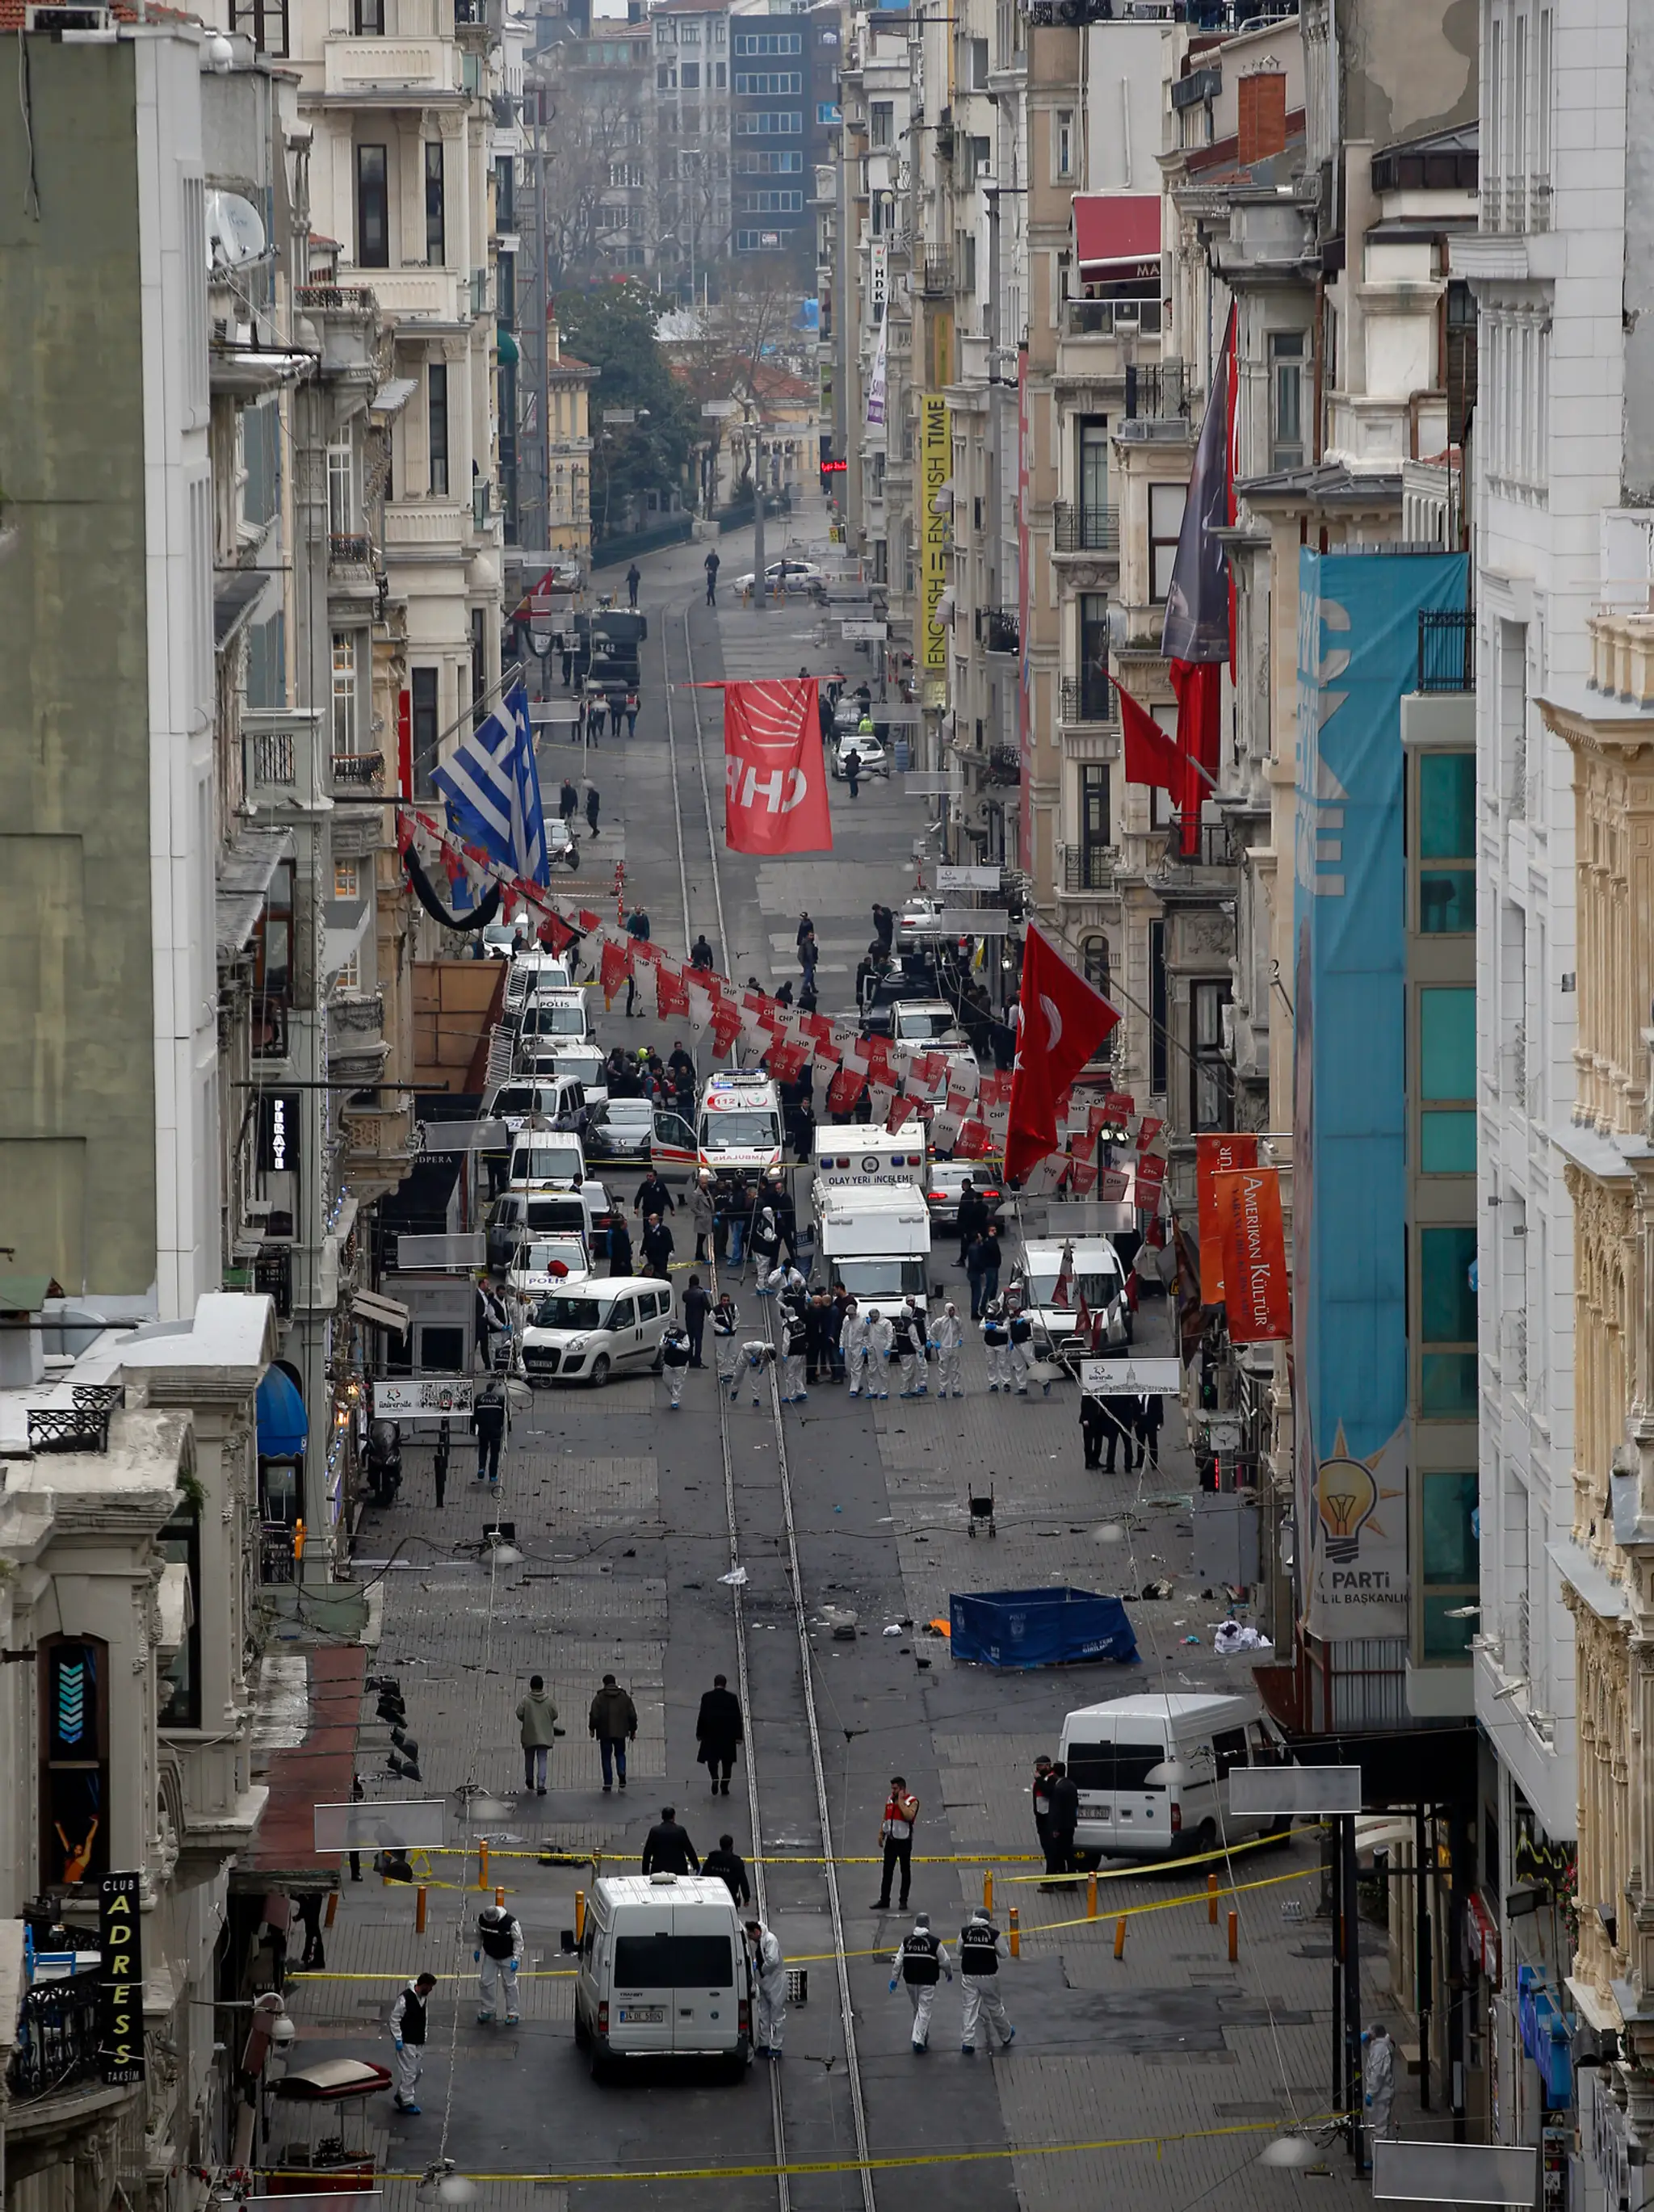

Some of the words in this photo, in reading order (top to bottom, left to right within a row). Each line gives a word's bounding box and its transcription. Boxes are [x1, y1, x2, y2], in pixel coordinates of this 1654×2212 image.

[874, 268, 884, 301] HDK
[928, 400, 945, 447] TIME
[779, 1014, 794, 1022] CHP
[835, 1034, 850, 1042] CHP
[872, 1055, 886, 1063] CHP
[716, 1098, 736, 1106] 112
[1094, 1095, 1106, 1106] CH
[989, 1111, 1005, 1119] CHP
[938, 1123, 953, 1132] CHP
[829, 1177, 850, 1185] OLAY
[103, 1880, 135, 1891] CLUB
[107, 1895, 132, 2064] ADRESS
[107, 2069, 140, 2084] TAKSİM
